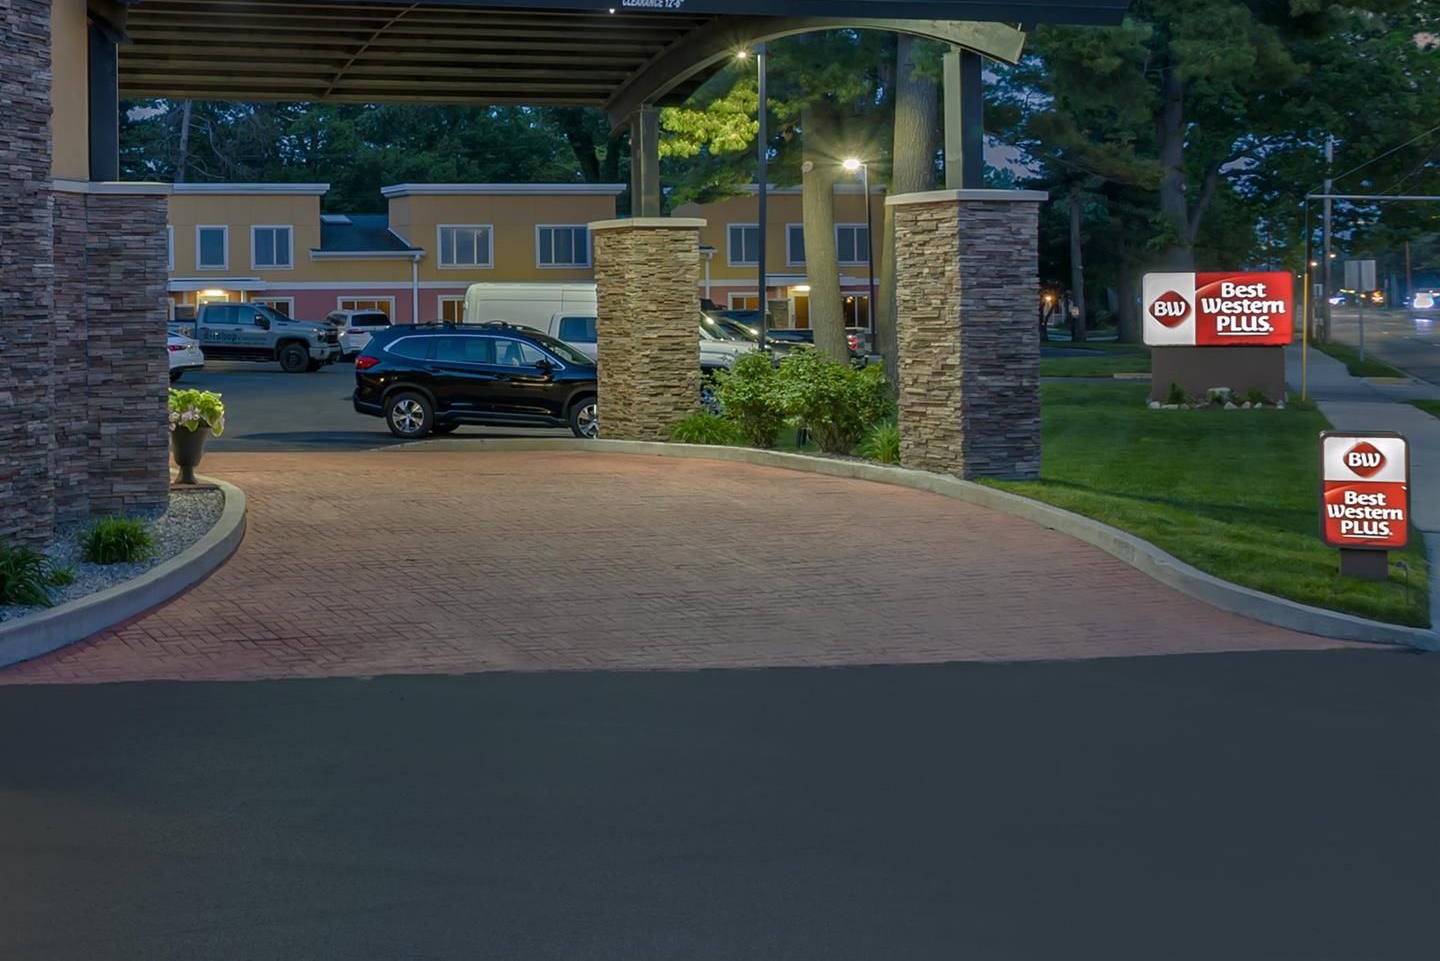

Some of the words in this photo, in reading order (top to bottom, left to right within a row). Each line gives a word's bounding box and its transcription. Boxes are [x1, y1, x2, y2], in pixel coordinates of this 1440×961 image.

[1221, 282, 1267, 298] Best
[1154, 301, 1186, 317] BW
[1201, 298, 1286, 314] Western
[1348, 452, 1381, 467] BW
[1344, 490, 1387, 506] Best
[1327, 504, 1404, 520] Western
